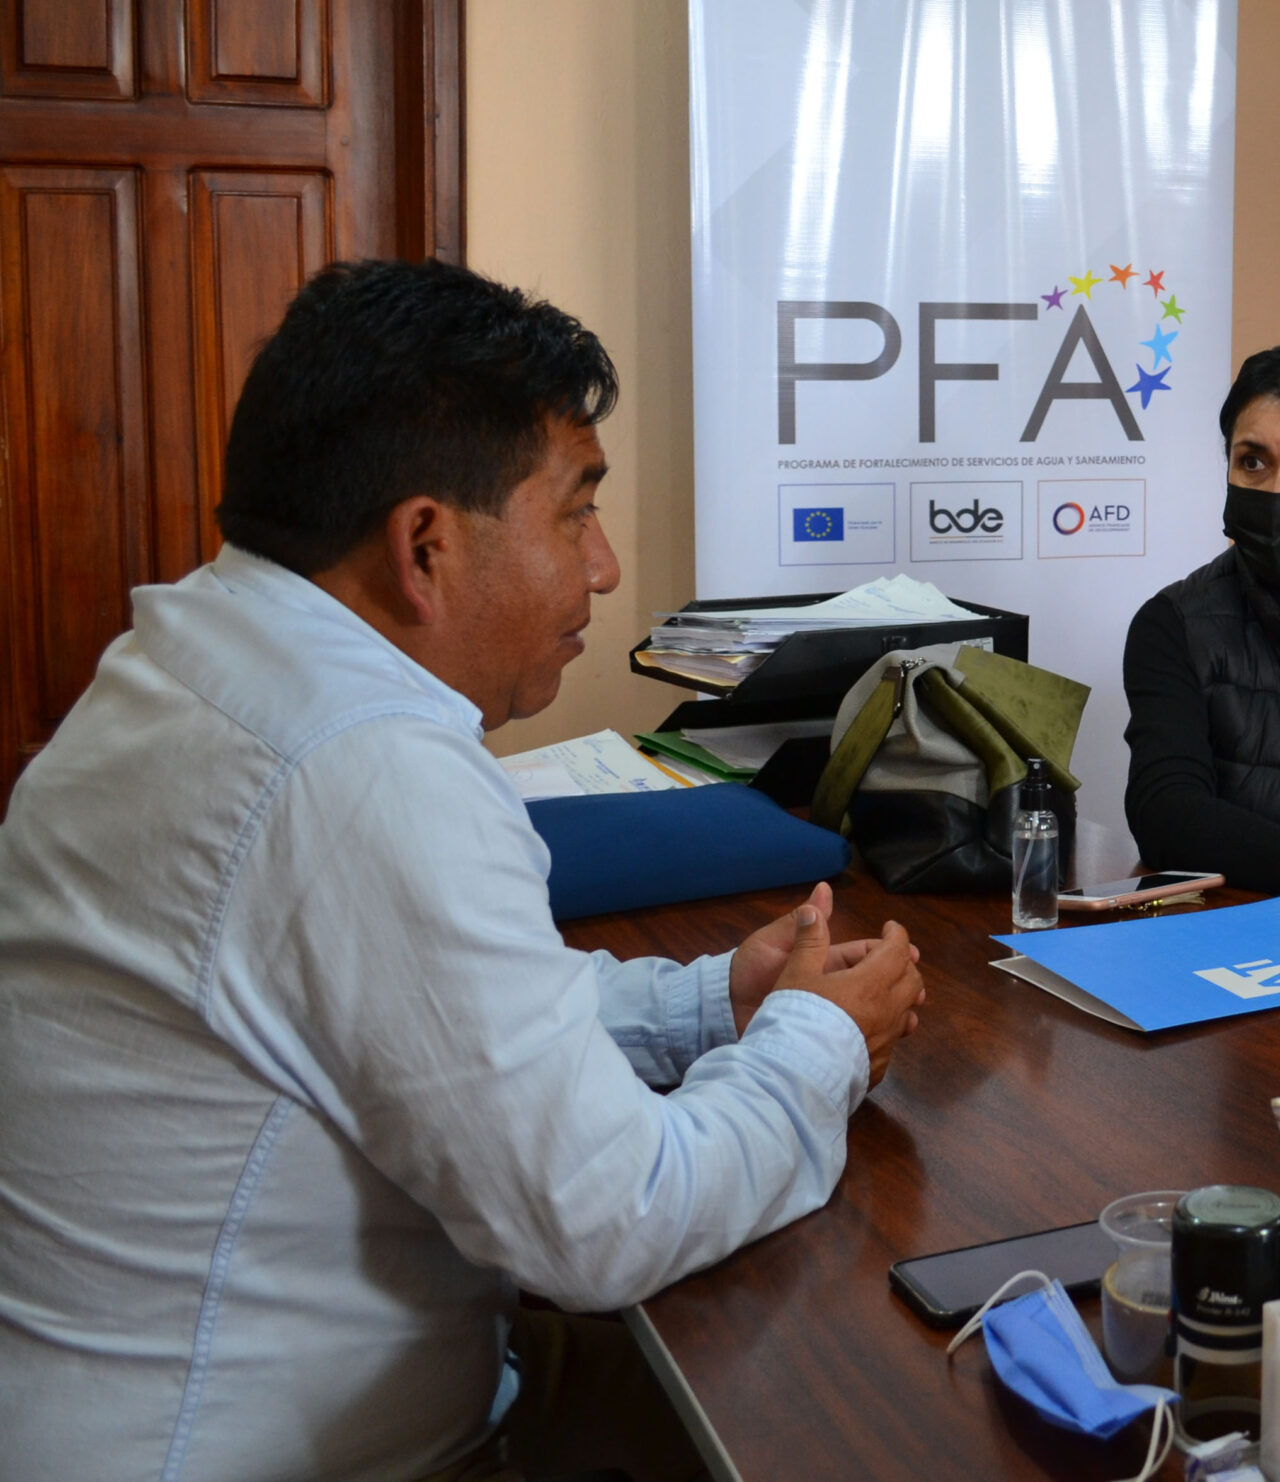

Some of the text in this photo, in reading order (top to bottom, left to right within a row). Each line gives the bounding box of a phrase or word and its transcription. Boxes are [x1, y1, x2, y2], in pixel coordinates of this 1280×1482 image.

[777, 300, 1145, 445] PFA
[777, 455, 1146, 470] PROGRAMA DE FORTALECIMIENTO DE SERVICIOS DE AGUA Y SANEAMIENTO
[929, 499, 1004, 534] bde
[1089, 505, 1130, 521] AFD
